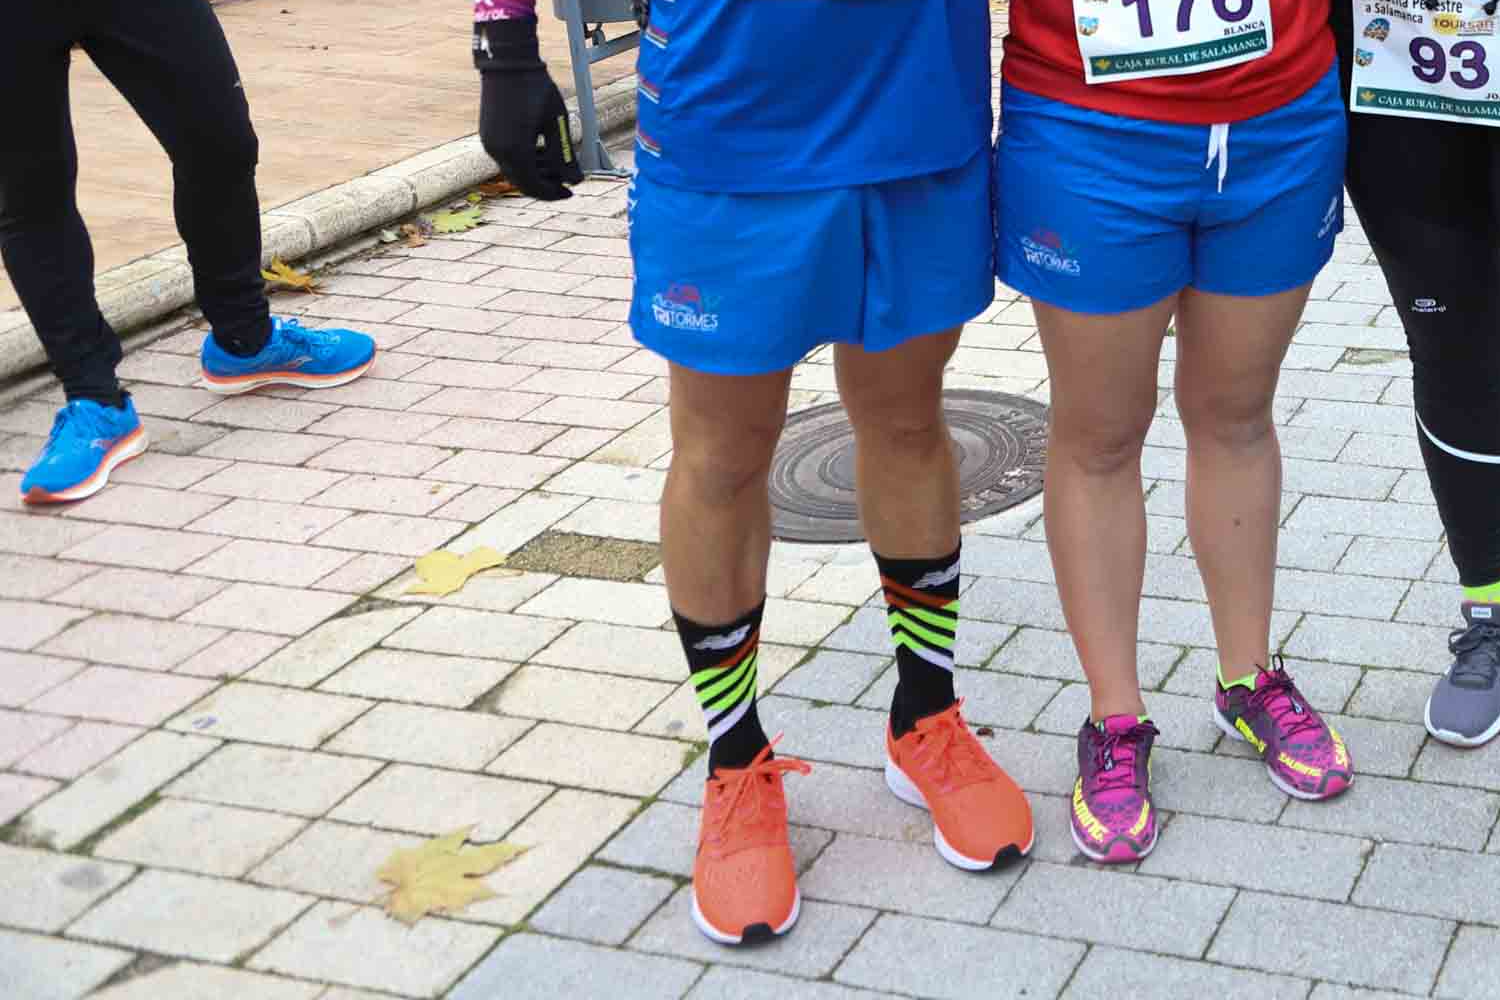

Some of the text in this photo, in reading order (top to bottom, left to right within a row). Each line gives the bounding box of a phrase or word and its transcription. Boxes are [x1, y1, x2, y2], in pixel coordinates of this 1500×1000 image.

[1366, 2, 1424, 24] a Salamanca
[1223, 20, 1265, 36] BLANCA
[1114, 37, 1266, 70] CAJA RURAL DE SALAMANCA
[1409, 36, 1490, 90] 93
[1378, 95, 1403, 106] CAJA
[1405, 98, 1439, 109] RURAL
[1440, 102, 1454, 111] DE
